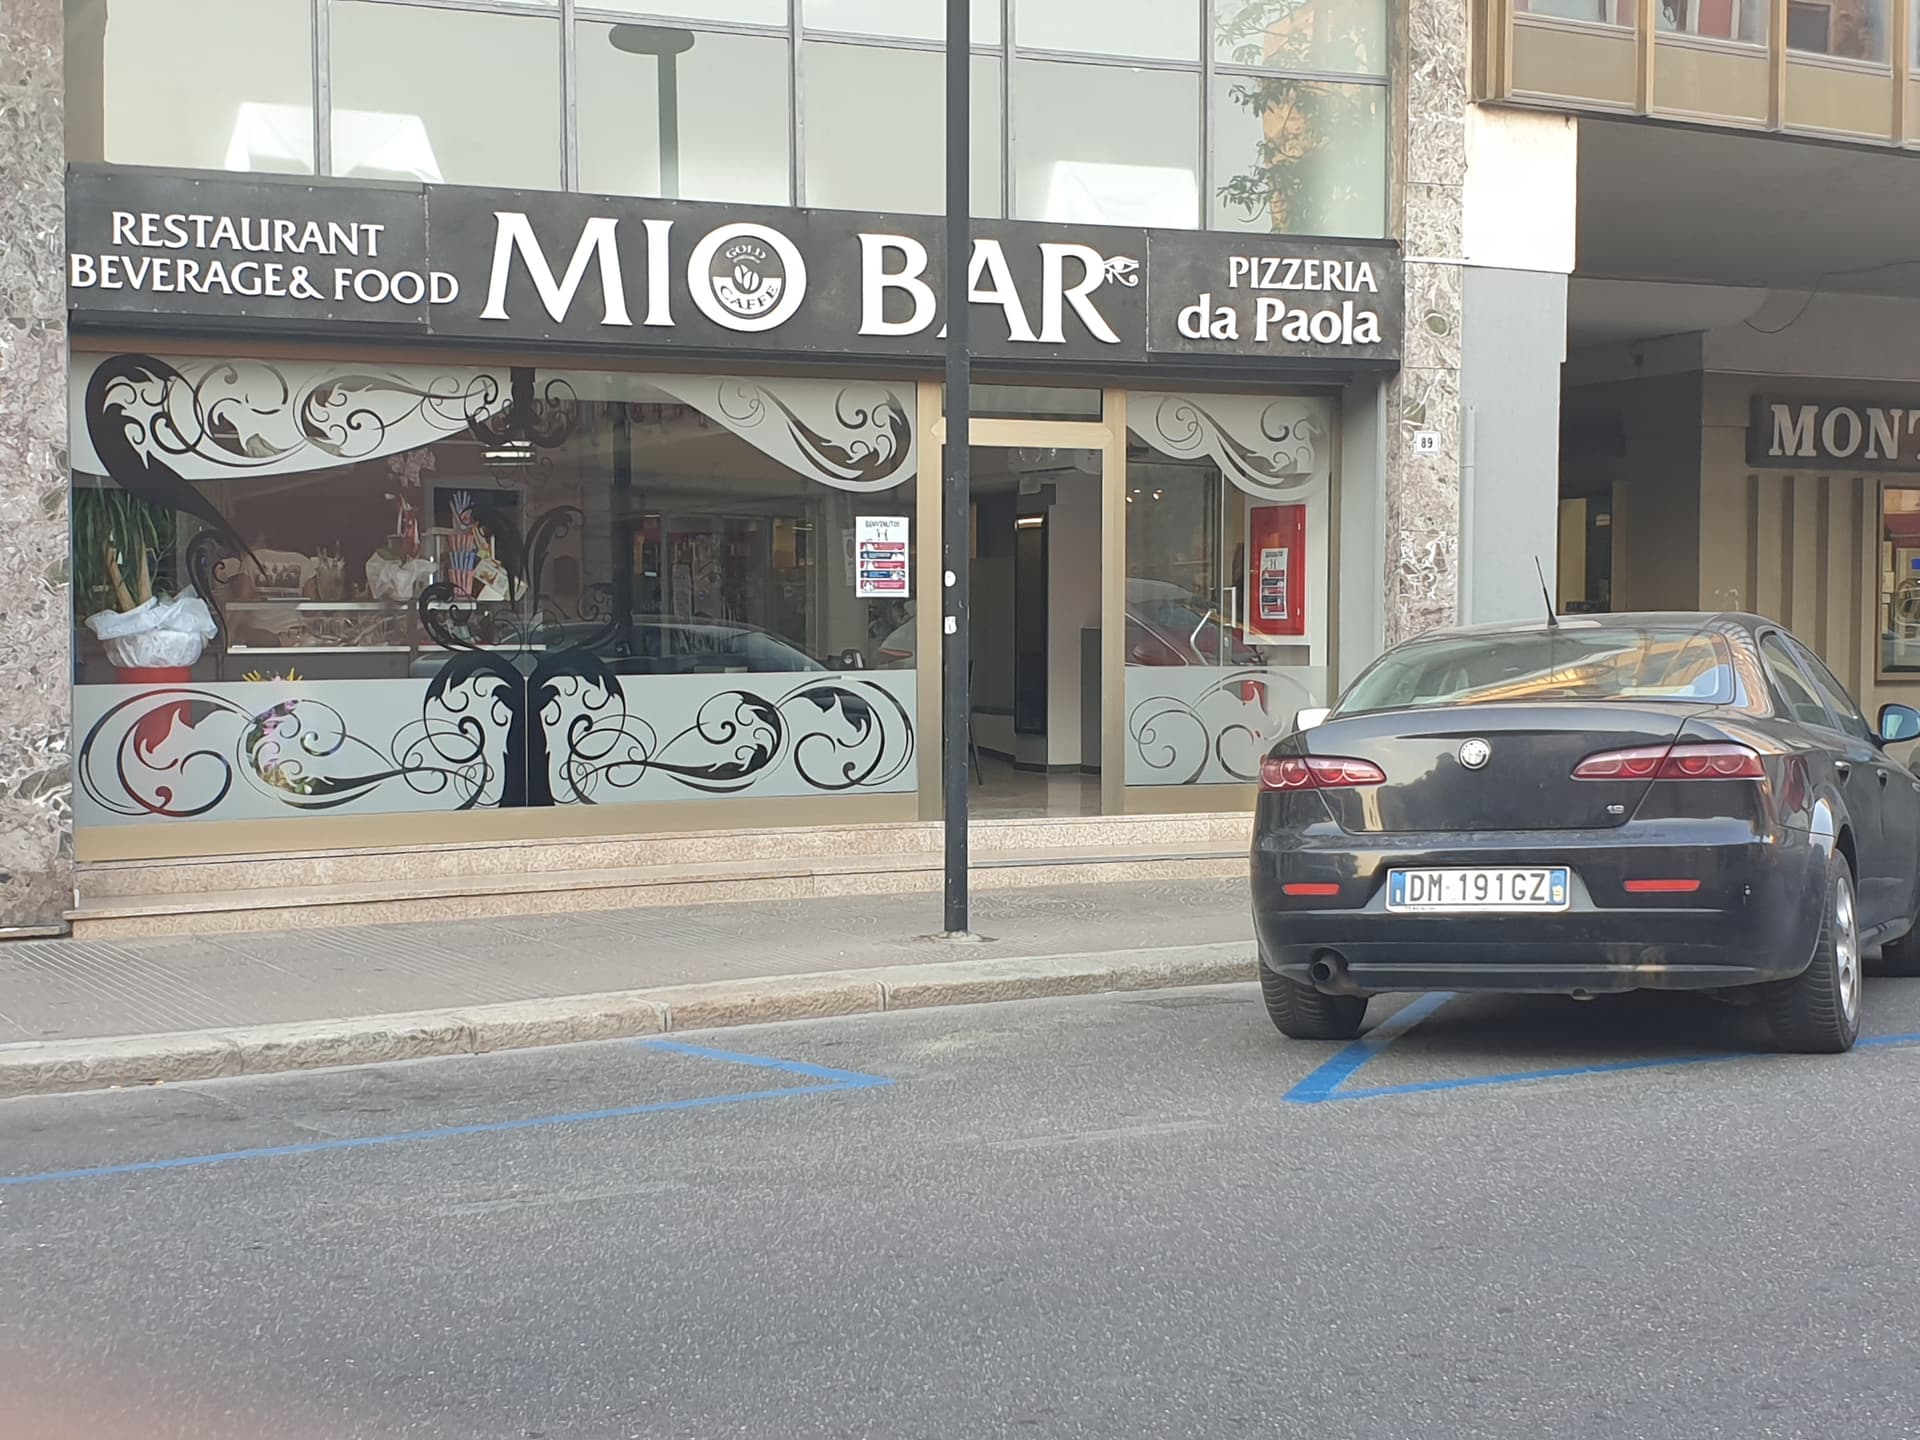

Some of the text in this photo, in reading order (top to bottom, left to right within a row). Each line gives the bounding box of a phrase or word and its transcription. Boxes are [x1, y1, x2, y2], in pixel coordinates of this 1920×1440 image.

[112, 211, 385, 258] RESTAURANT
[725, 244, 766, 259] GOLD
[70, 252, 459, 305] BEVERAGE& FOOD
[480, 211, 1121, 344] MIO BAR
[1228, 256, 1379, 293] PIZZERIA
[1177, 292, 1382, 345] da Paola
[1421, 437, 1433, 449] 89
[1410, 873, 1442, 902] DM
[1459, 873, 1546, 902] 191GZ
